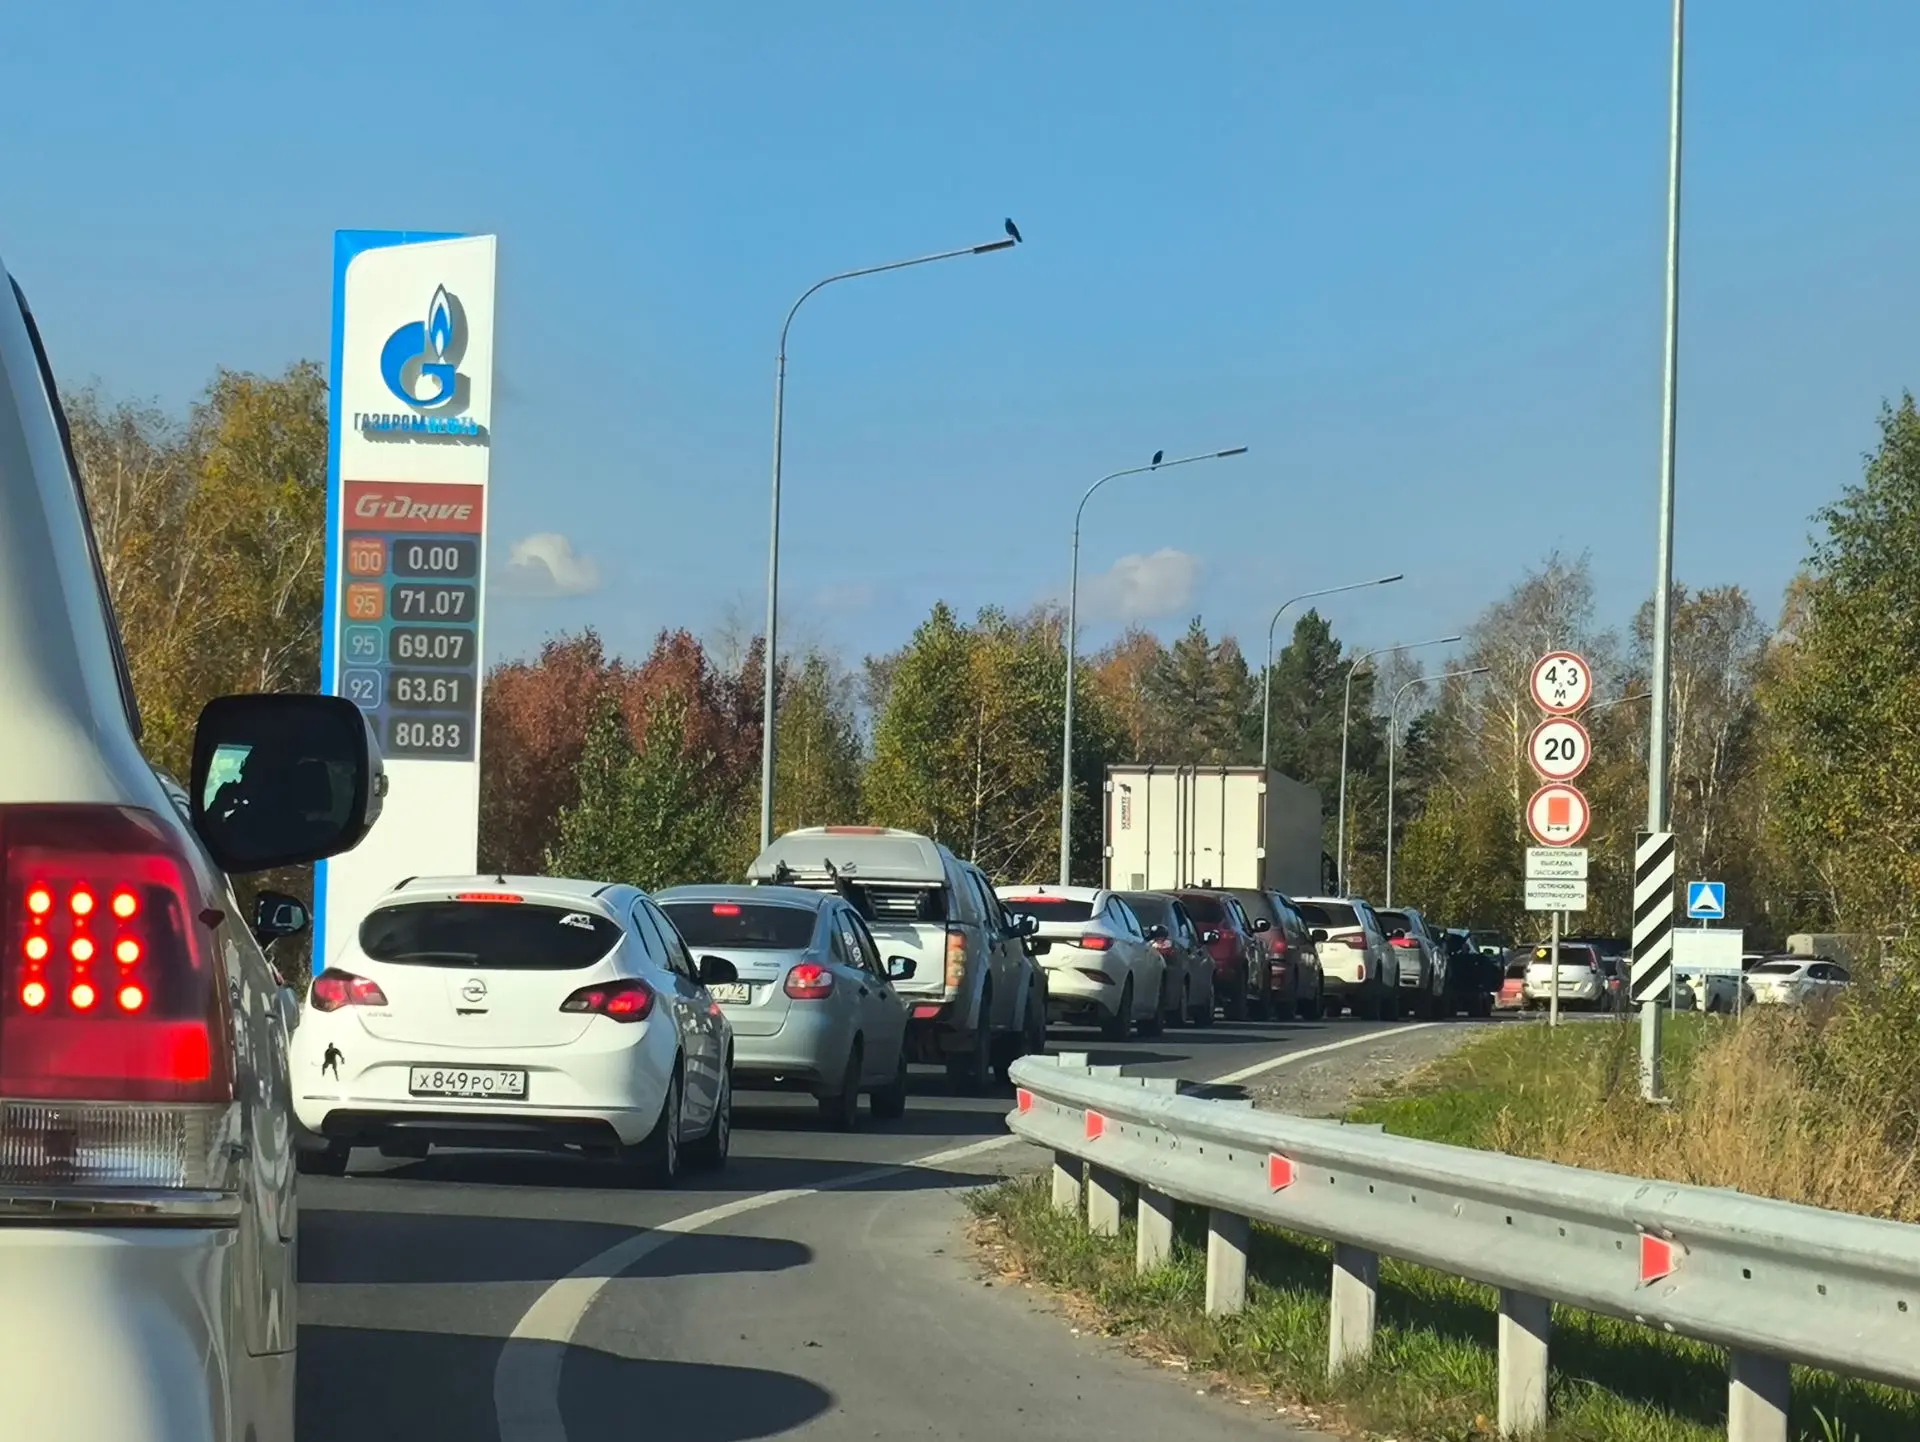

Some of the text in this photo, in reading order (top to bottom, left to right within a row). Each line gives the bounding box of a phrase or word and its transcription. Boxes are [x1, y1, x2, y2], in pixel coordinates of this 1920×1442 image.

[352, 546, 459, 571] 100 0.00
[353, 590, 465, 615] 95 71.07
[351, 634, 464, 659] 95 69.07
[350, 678, 459, 703] 92 63.61
[395, 722, 461, 748] 80.83
[1544, 737, 1575, 761] 20
[500, 1072, 518, 1087] 72
